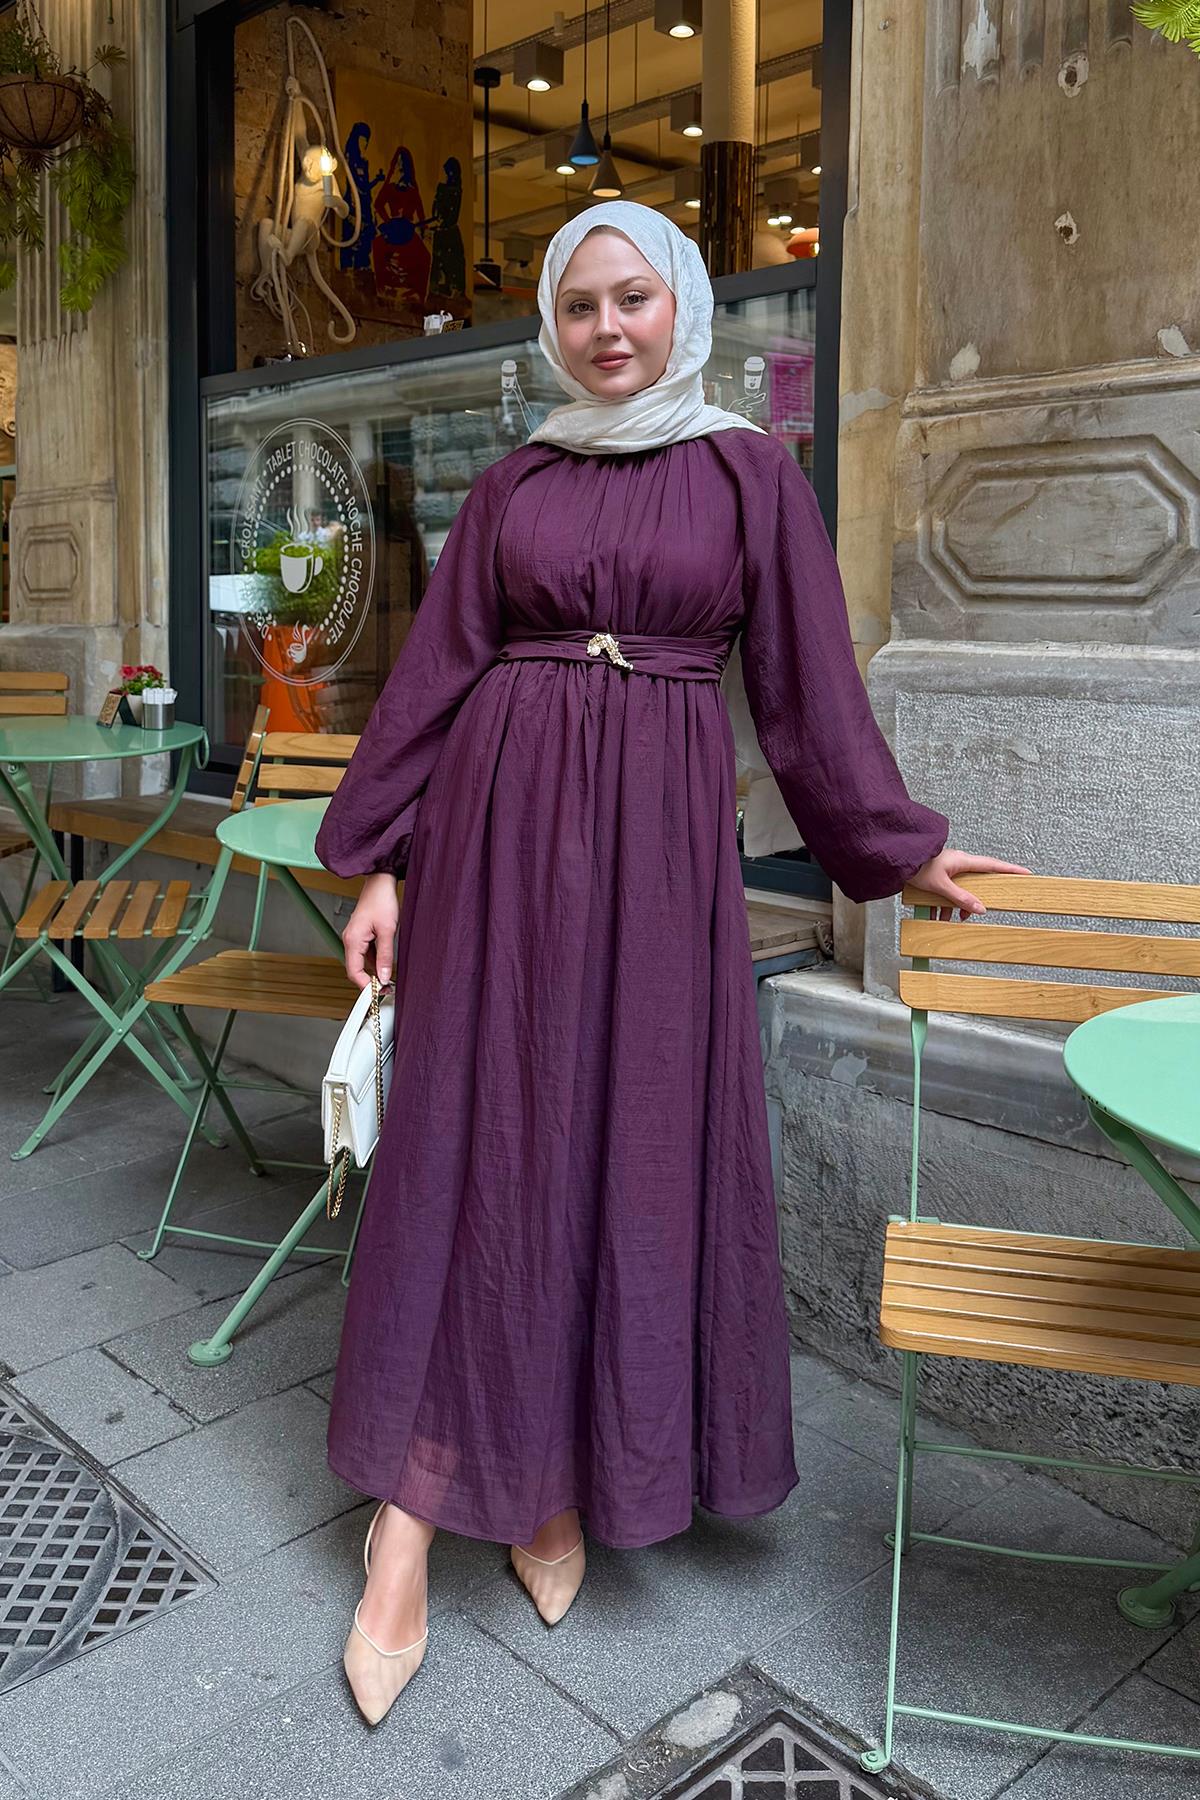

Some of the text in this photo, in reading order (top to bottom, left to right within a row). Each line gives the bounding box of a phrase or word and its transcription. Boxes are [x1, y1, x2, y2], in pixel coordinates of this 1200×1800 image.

[266, 440, 348, 490] TABLET CHOCOLATE
[241, 475, 266, 559] CROISSANT
[328, 496, 363, 644] ROCHE CHOCOLATE
